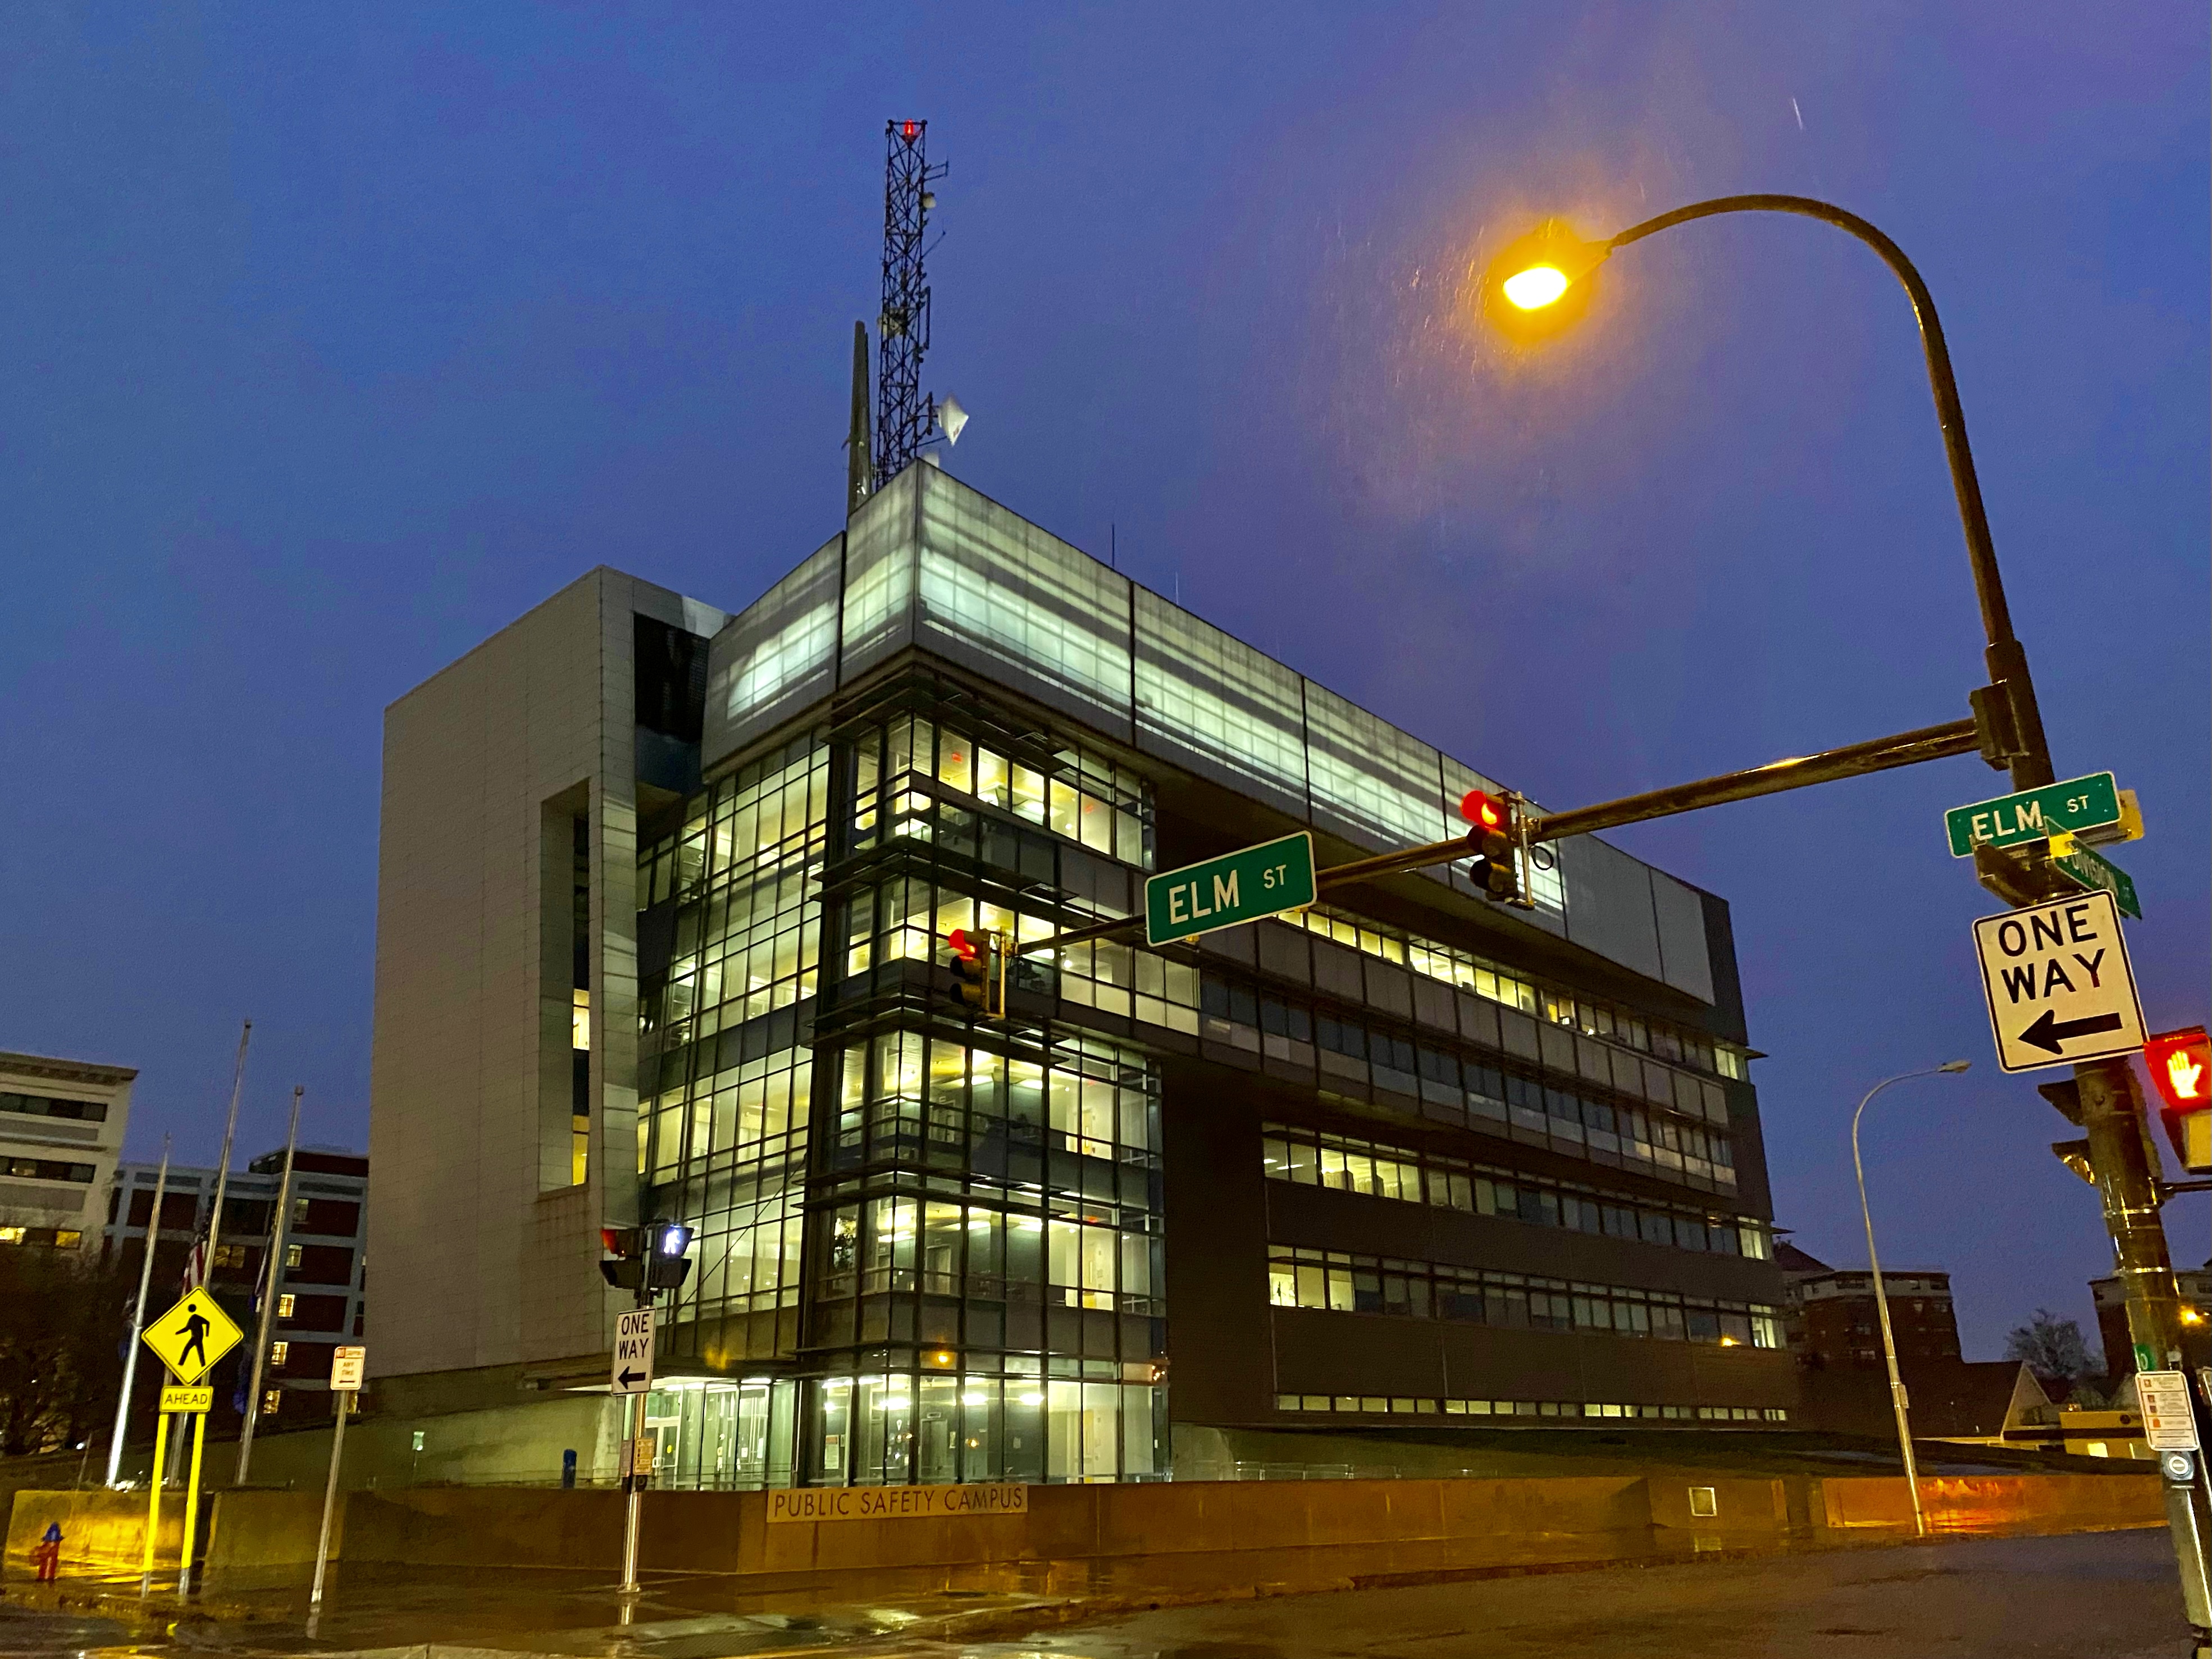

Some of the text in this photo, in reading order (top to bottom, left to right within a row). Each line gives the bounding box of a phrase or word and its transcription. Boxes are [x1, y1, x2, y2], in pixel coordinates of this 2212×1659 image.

[1971, 795, 2089, 841] ELM ST
[1169, 864, 1287, 924] ELM ST
[1998, 903, 2099, 957] ONE
[2000, 947, 2106, 1004] WAY
[621, 1313, 650, 1336] ONE
[619, 1337, 649, 1360] WAY
[165, 1393, 208, 1405] AHEAD
[774, 1487, 1022, 1517] PUBLIC SAFETY CAMPUS
